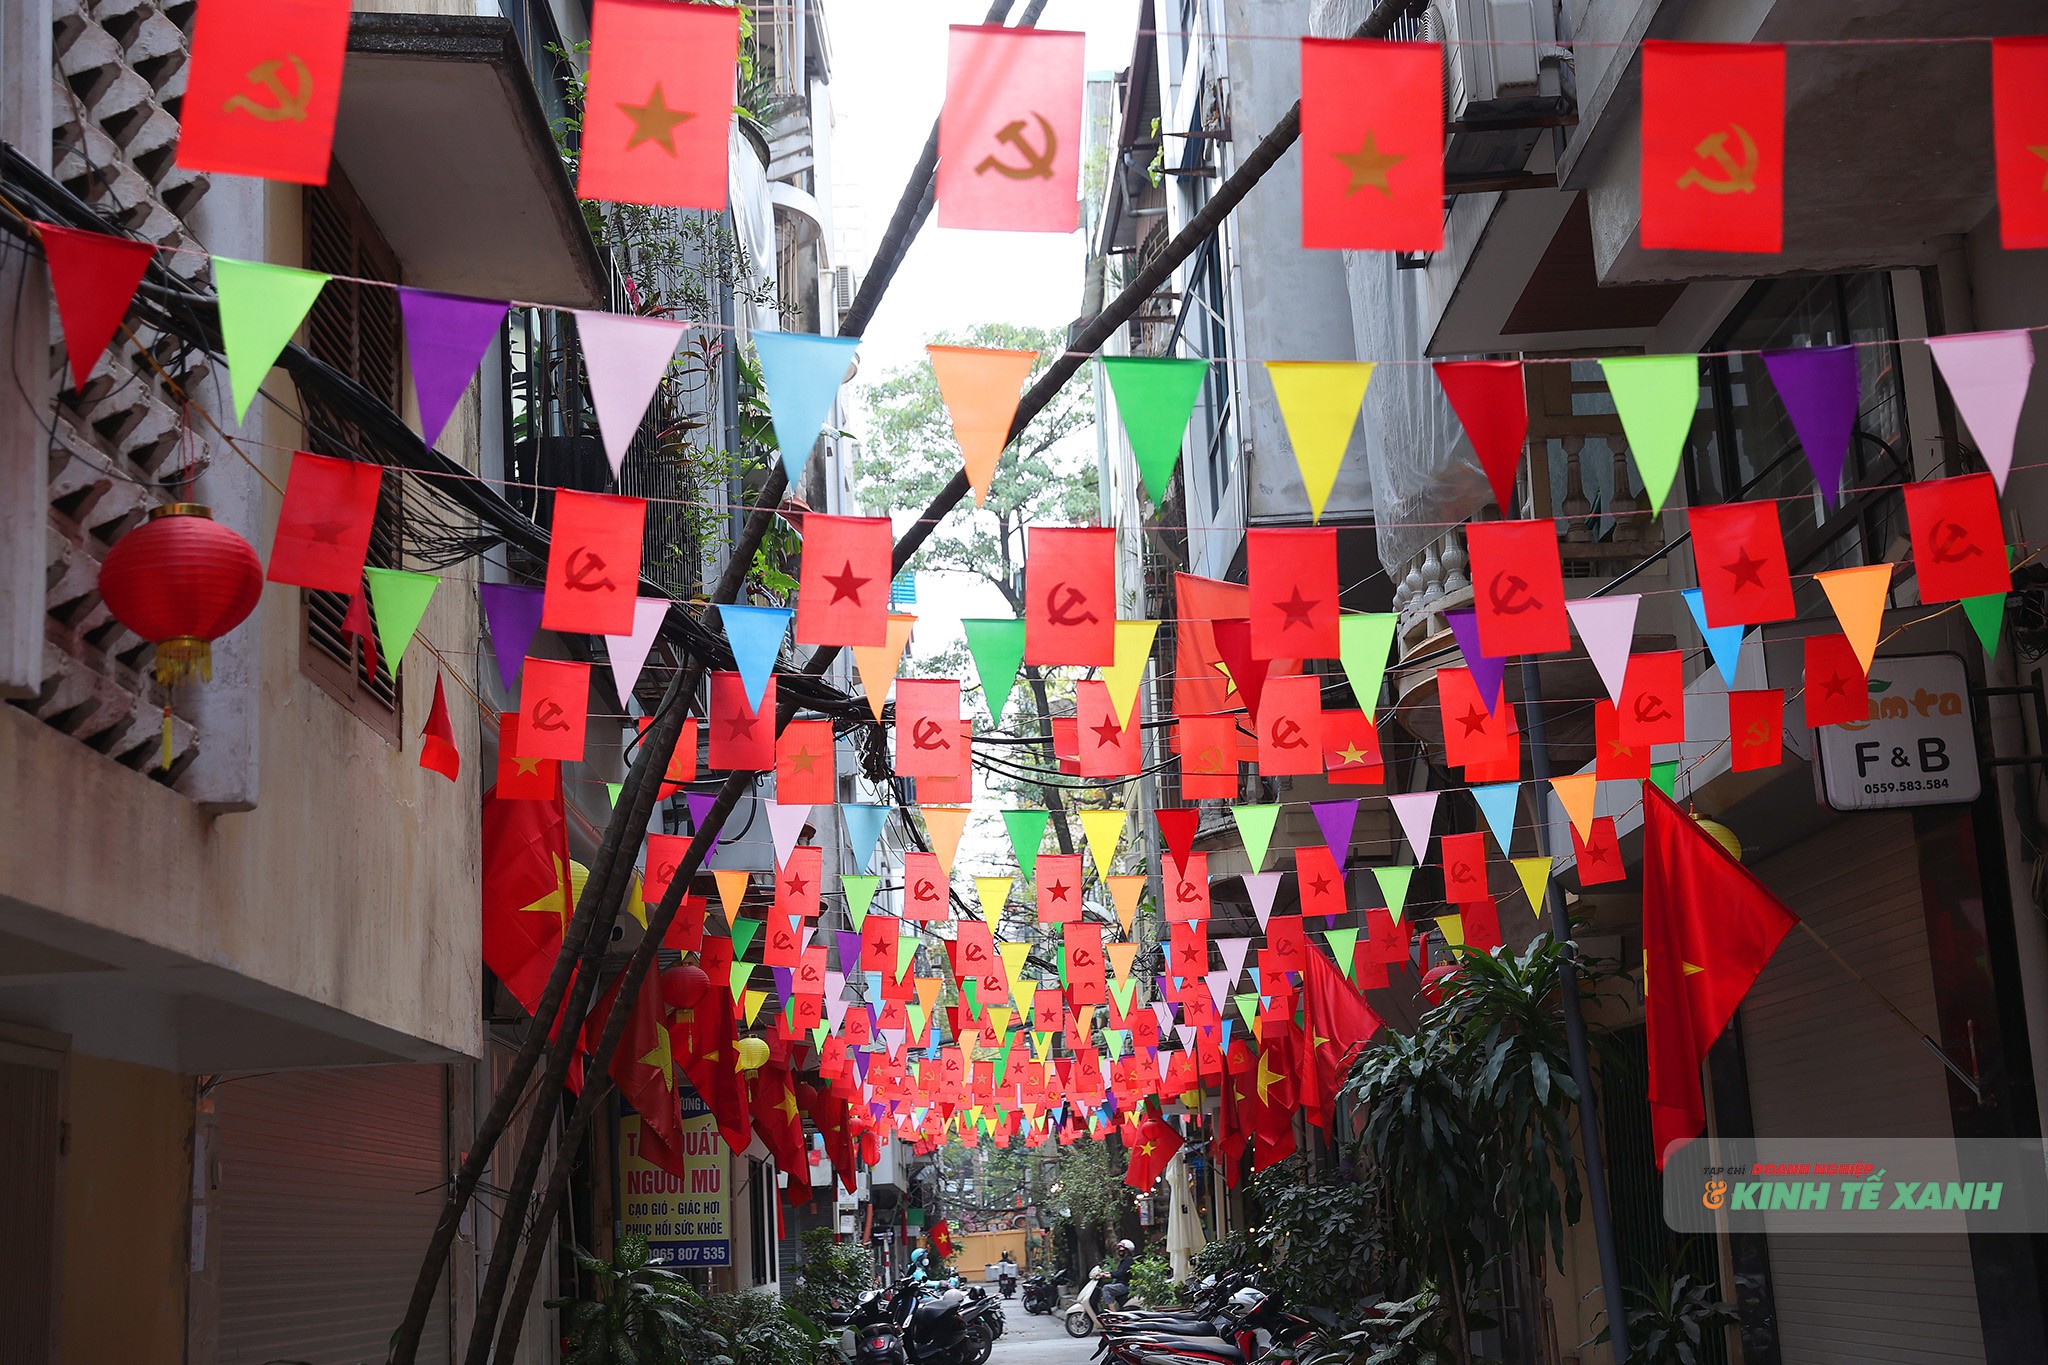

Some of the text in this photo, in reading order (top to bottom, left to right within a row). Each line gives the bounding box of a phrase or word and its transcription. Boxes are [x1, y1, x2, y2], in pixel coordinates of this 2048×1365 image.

[1836, 688, 1962, 731] amta
[1855, 737, 1950, 778] F & B
[1864, 778, 1949, 794] 0559.583.584
[682, 1122, 721, 1156] UẤT
[691, 1163, 721, 1194] MÙ
[628, 1203, 648, 1218] CẠO
[651, 1200, 668, 1216] GIÓ
[677, 1199, 700, 1215] GIÁC
[703, 1201, 720, 1215] HƠI
[655, 1219, 672, 1236] HỒI
[674, 1219, 694, 1236] SỨC
[697, 1217, 723, 1235] KHỎE
[677, 1247, 700, 1261] 807
[703, 1246, 726, 1260] 535
